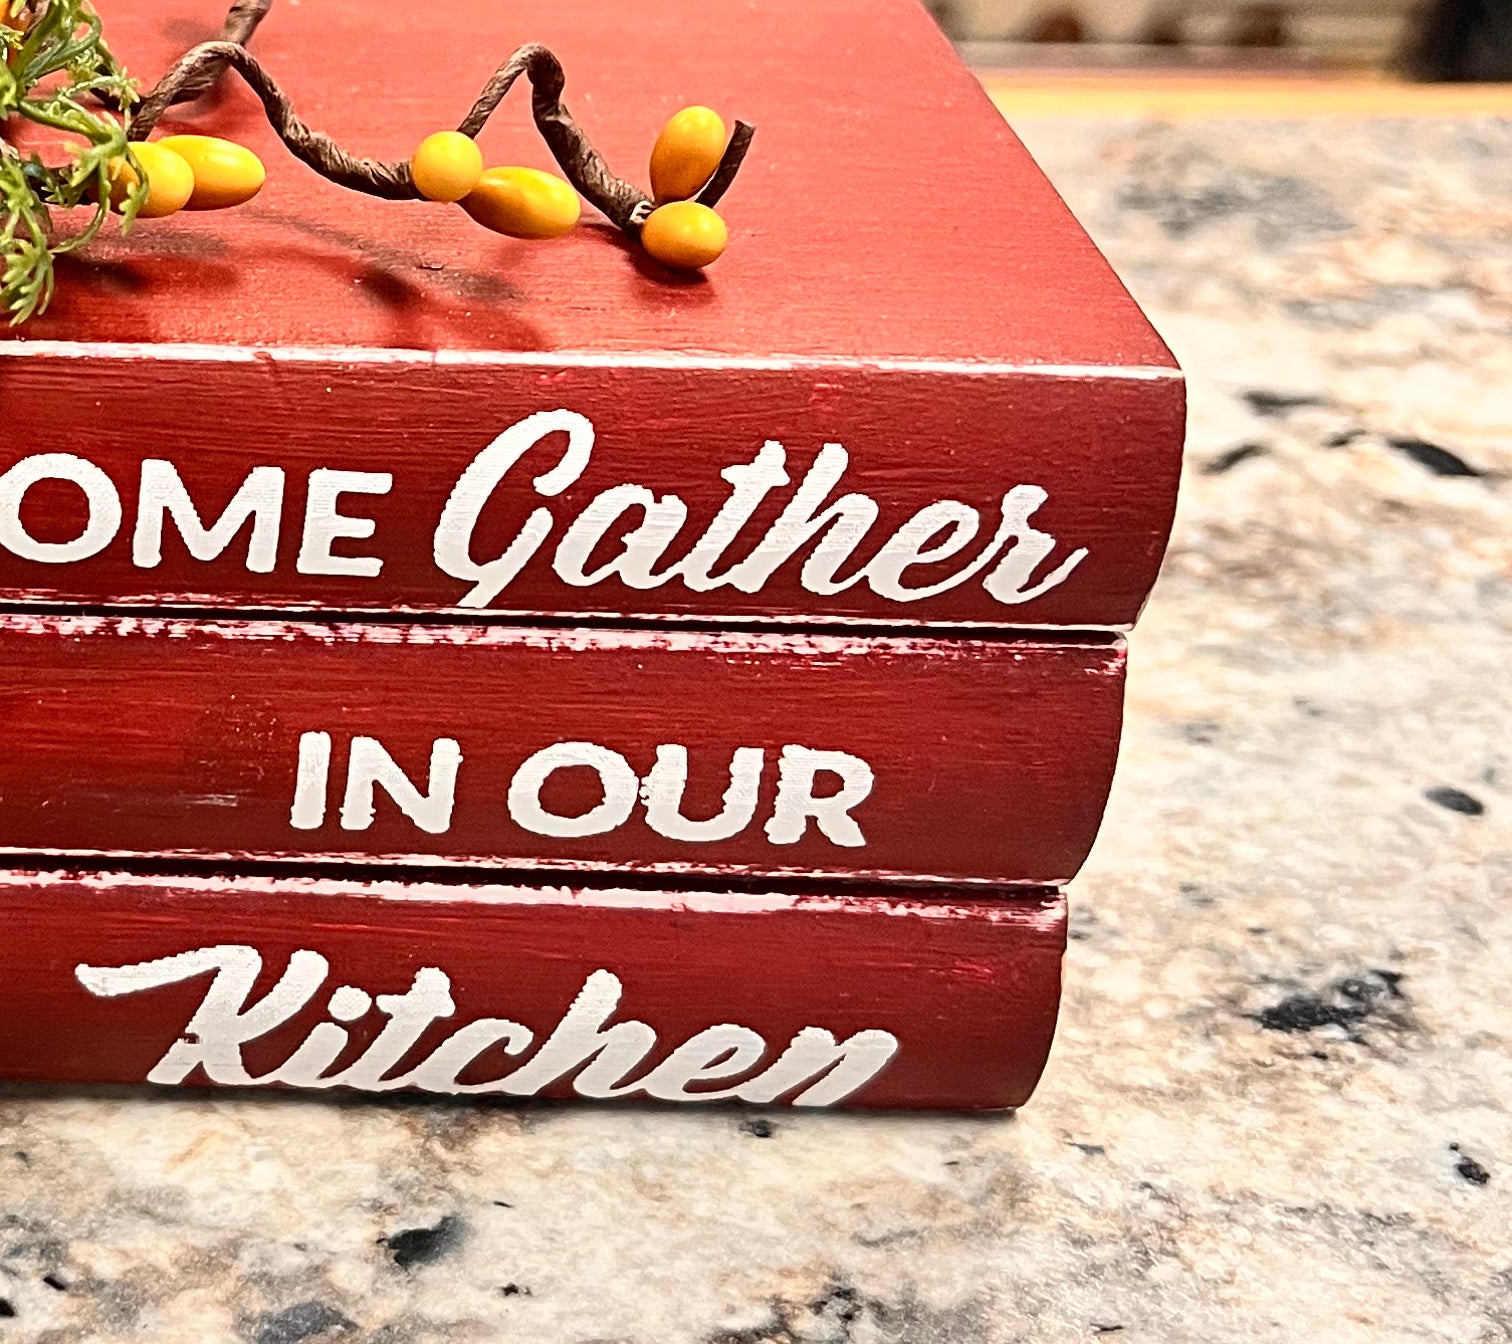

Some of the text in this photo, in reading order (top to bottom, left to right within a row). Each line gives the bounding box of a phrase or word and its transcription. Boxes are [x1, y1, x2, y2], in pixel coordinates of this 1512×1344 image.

[433, 408, 1088, 609] Gather
[290, 731, 875, 848] IN OUR
[75, 945, 899, 1107] Kitchen
